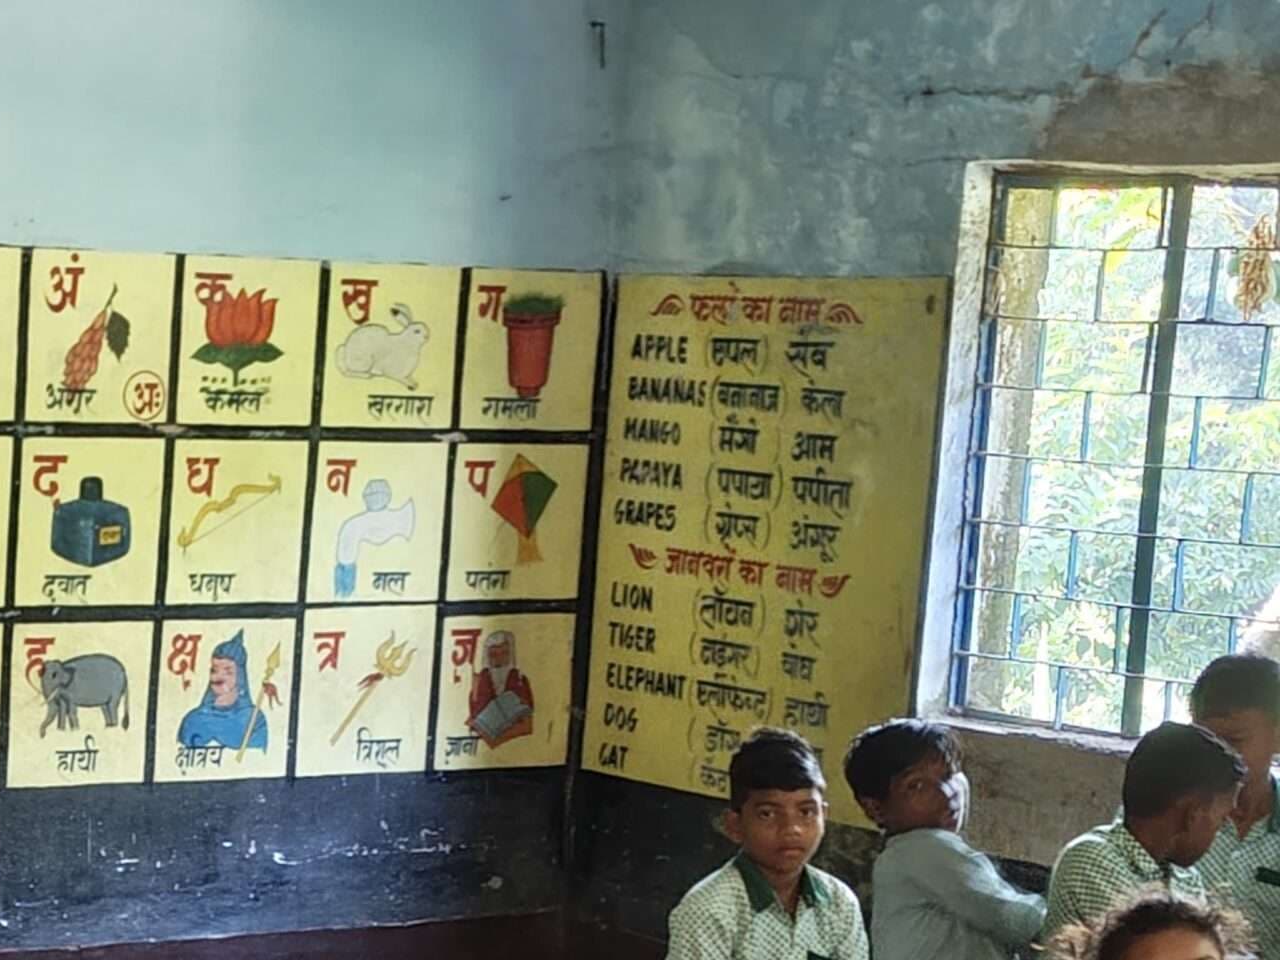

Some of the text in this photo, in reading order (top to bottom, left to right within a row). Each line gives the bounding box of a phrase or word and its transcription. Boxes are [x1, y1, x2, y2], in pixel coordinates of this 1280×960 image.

[46, 253, 85, 313] अं
[341, 279, 378, 324] ख
[478, 285, 507, 321] ग
[741, 294, 773, 323] का
[779, 296, 826, 324] नाम
[631, 334, 688, 364] APPLE
[628, 376, 707, 408] BANANAS
[624, 417, 682, 446] MANGO
[792, 431, 839, 463] आम
[32, 455, 68, 511] द
[326, 459, 357, 496] न
[464, 460, 496, 498] प
[620, 457, 683, 490] PAPAYA
[615, 498, 677, 532] GRAPES
[372, 571, 411, 595] नल
[739, 559, 769, 586] का
[776, 564, 817, 596] नाम
[611, 581, 653, 612] LION
[314, 631, 346, 671] त्र
[608, 621, 657, 653] TIGER
[24, 637, 55, 703] ह
[606, 662, 686, 700] ELEPHANT
[603, 703, 638, 733] DOG
[598, 742, 628, 772] CAT
